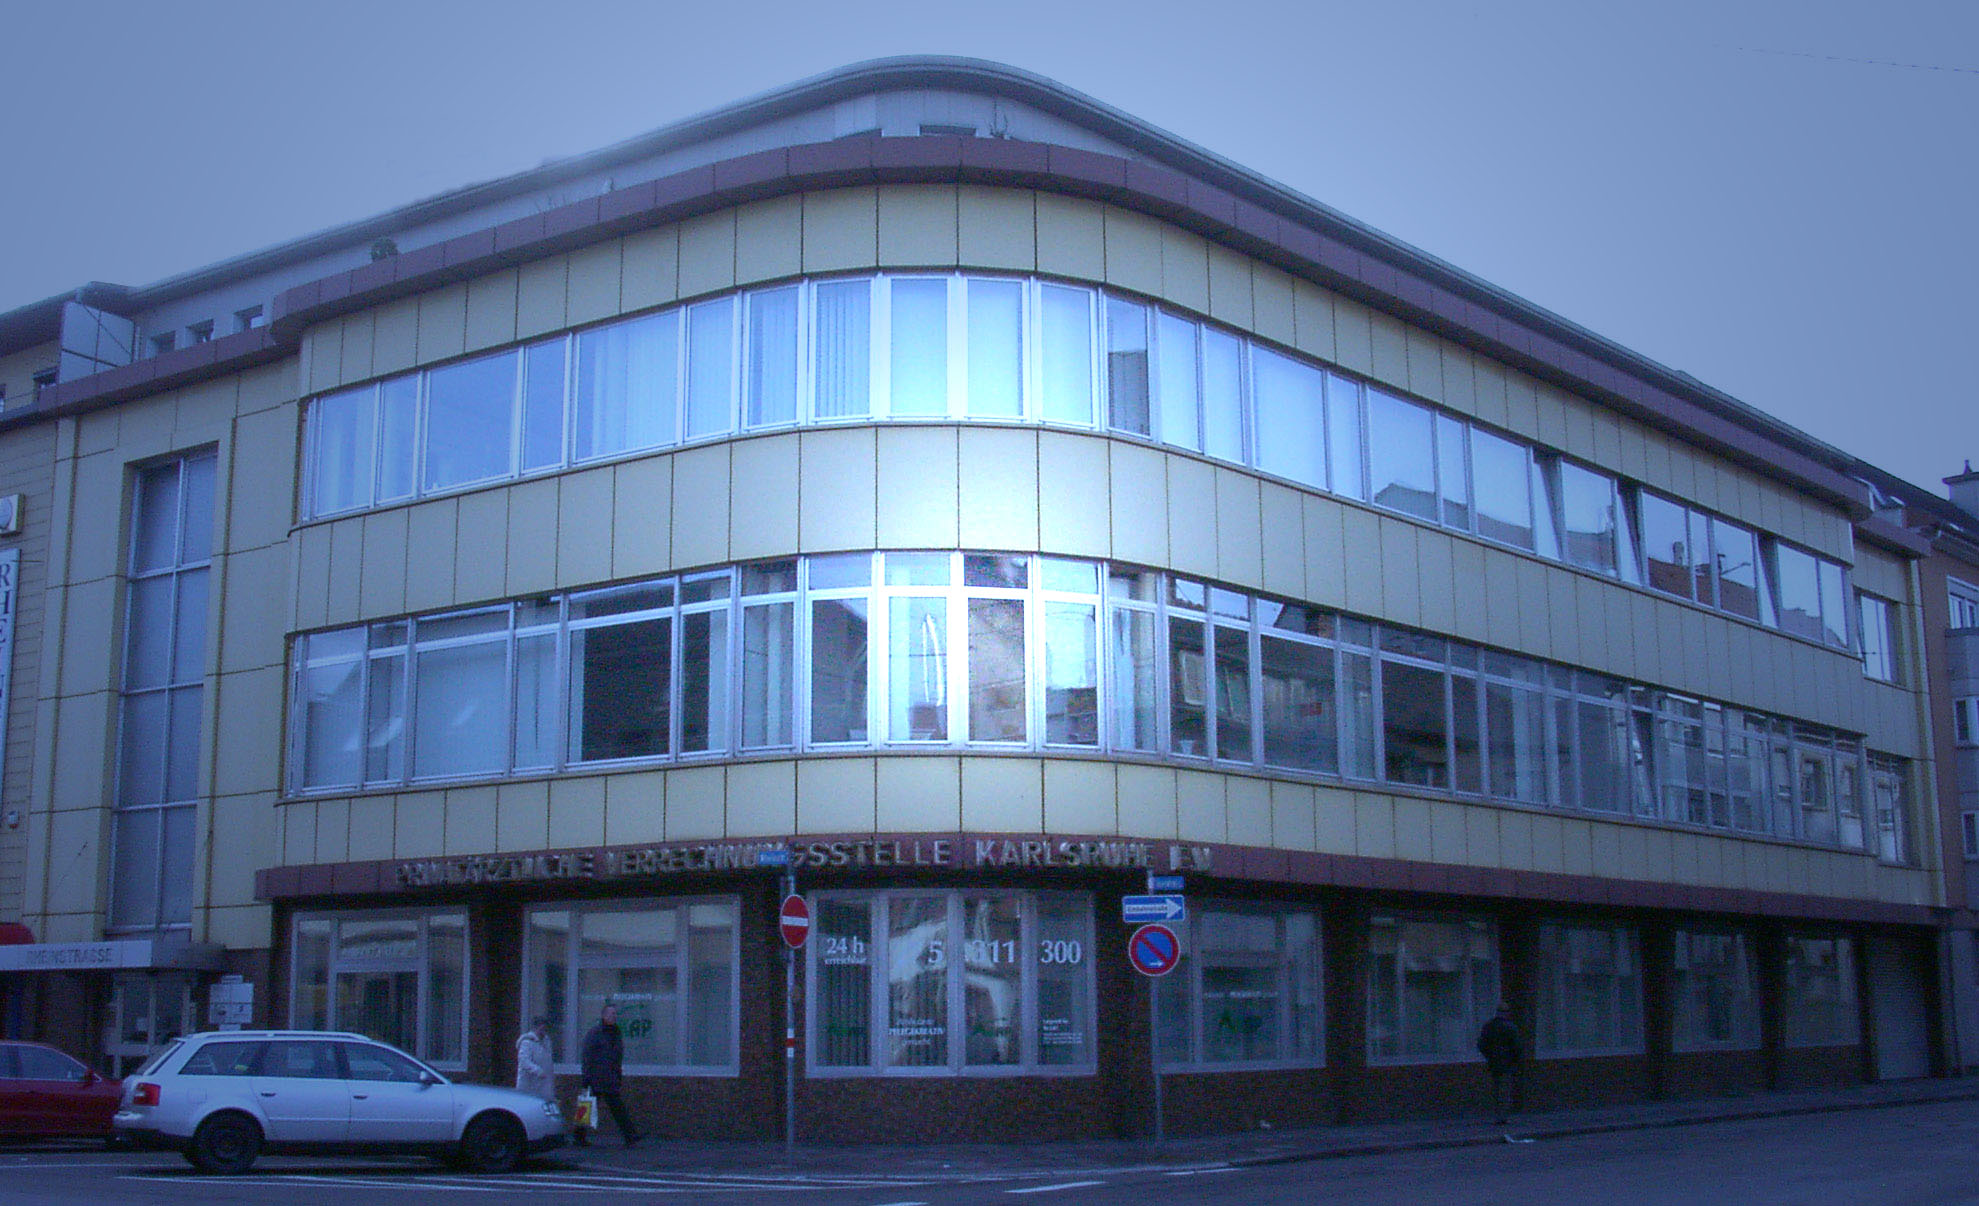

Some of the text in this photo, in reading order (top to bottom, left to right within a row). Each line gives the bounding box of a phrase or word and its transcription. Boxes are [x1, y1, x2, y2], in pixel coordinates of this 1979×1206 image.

[976, 840, 1154, 867] KARLSRUHE
[826, 936, 864, 954] 24 h
[1041, 940, 1081, 964] 300
